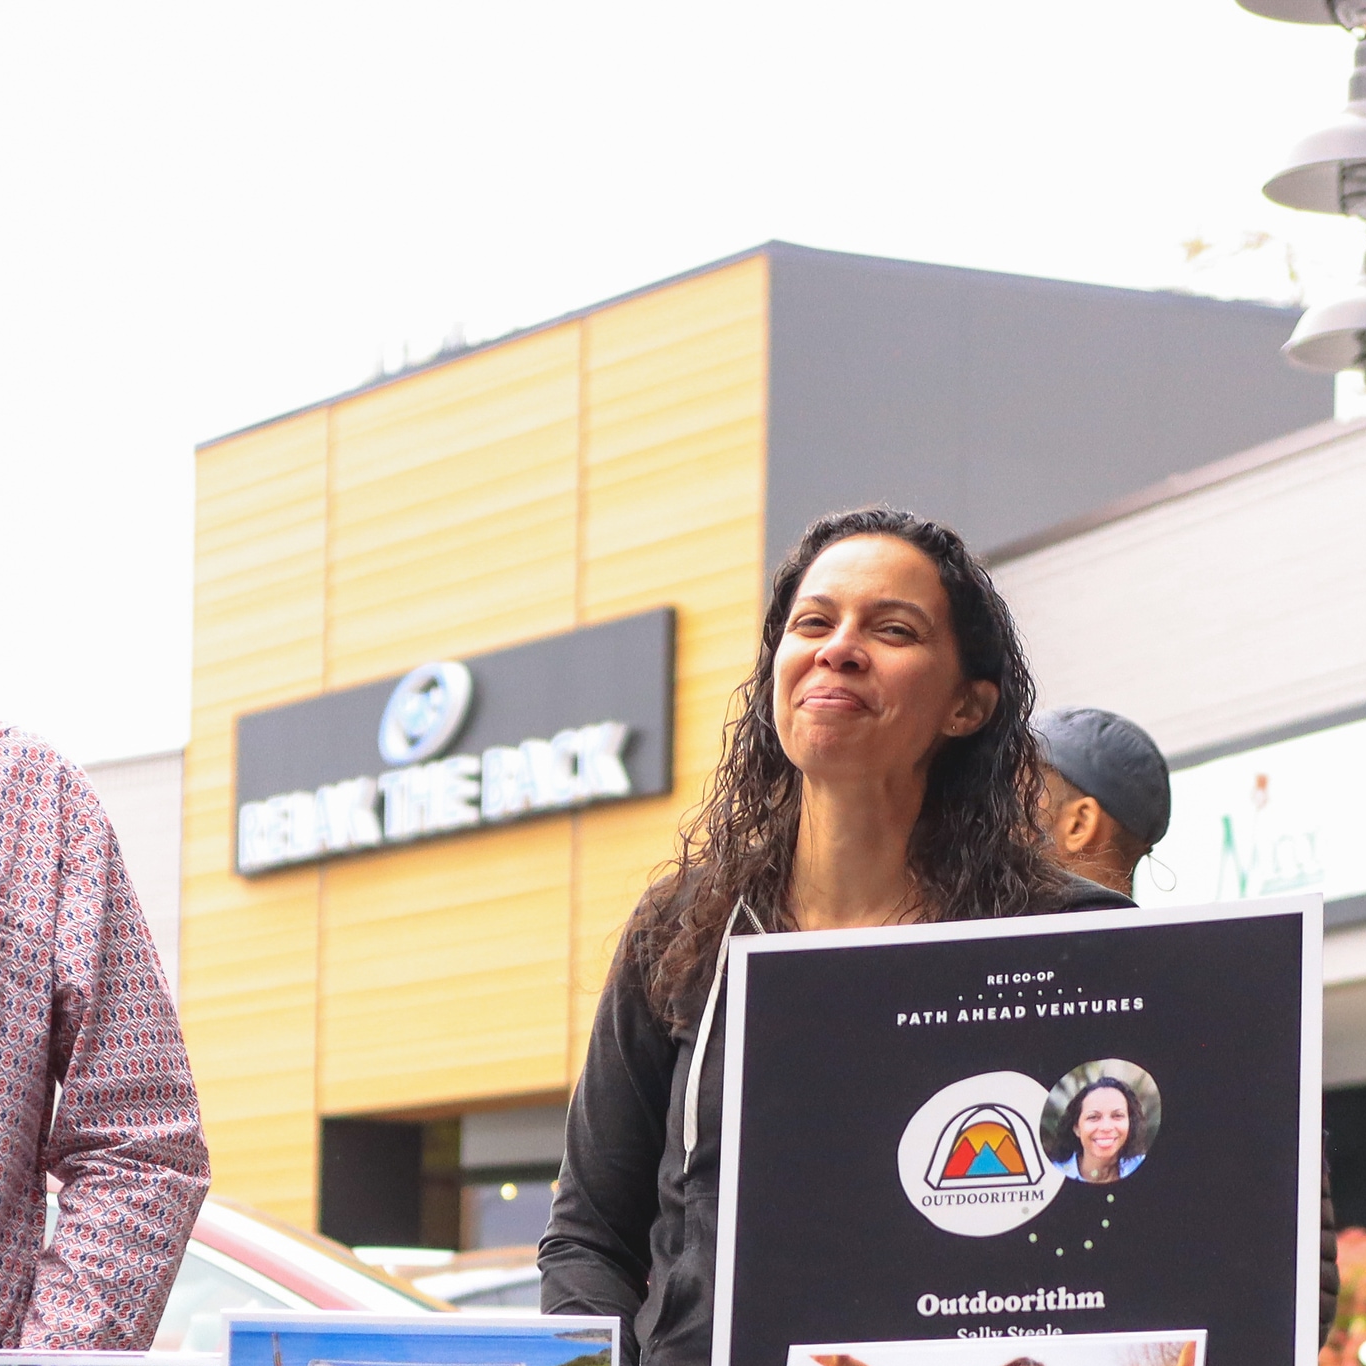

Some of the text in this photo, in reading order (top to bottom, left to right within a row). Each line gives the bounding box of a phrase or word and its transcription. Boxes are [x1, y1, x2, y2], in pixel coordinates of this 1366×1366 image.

[987, 971, 1055, 986] REI CO-OP
[896, 997, 1144, 1026] PATH AHEAD VENTURES
[922, 1189, 1045, 1207] OUTDOORITHM
[916, 1286, 1106, 1317] Outdoorithm
[1007, 1323, 1063, 1338] Steele
